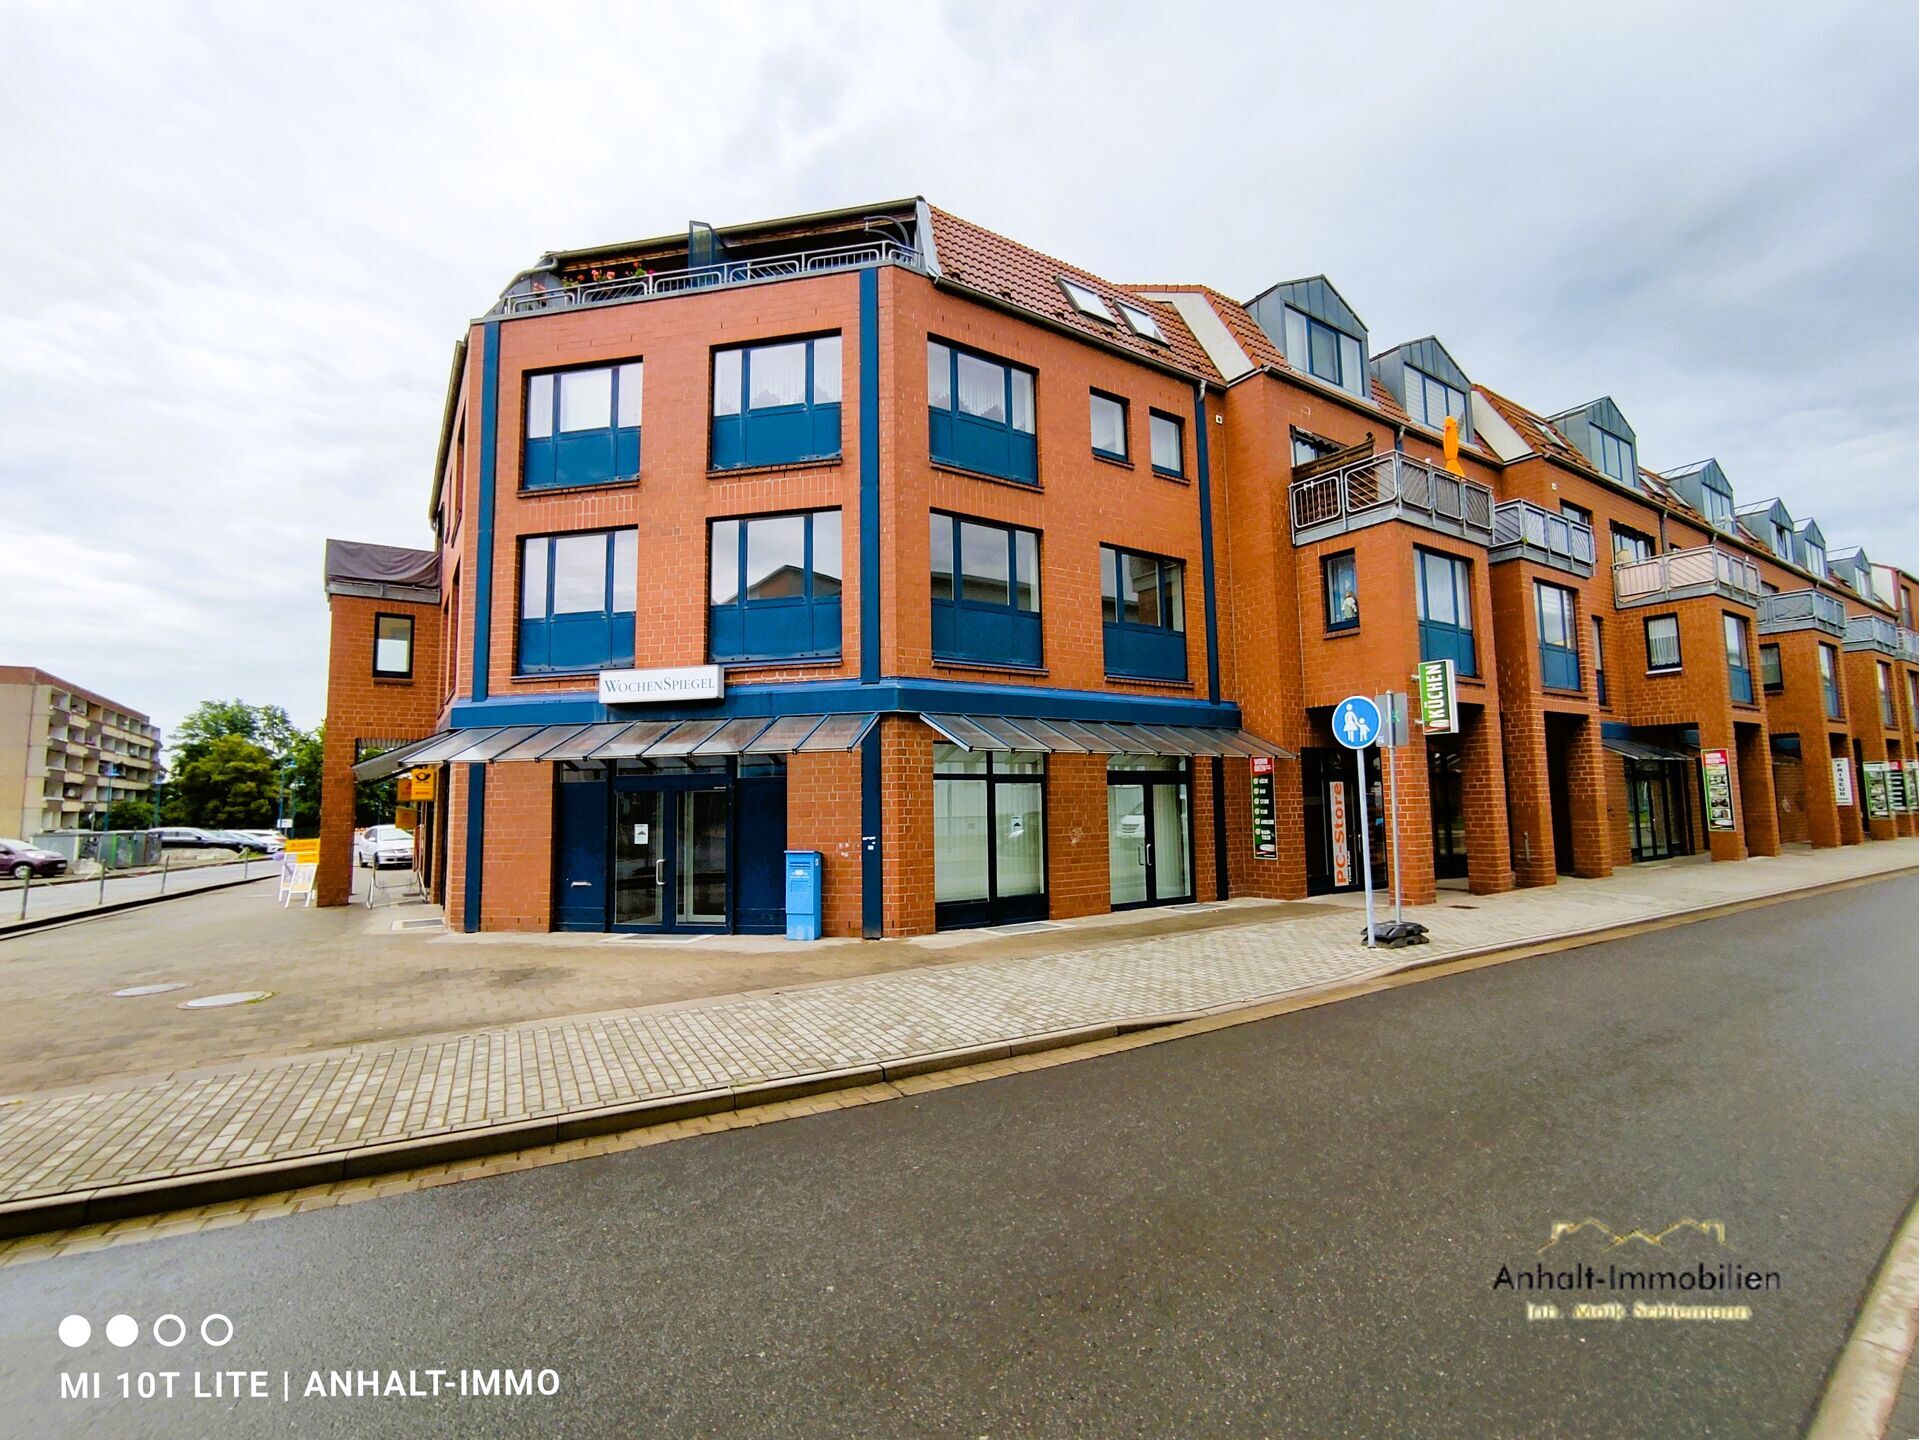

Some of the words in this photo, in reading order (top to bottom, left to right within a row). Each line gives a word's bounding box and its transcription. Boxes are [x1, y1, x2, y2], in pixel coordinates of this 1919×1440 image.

[1424, 664, 1446, 719] KÜCHEN
[1836, 763, 1846, 797] FRISEUR
[1333, 782, 1347, 884] PC-Store
